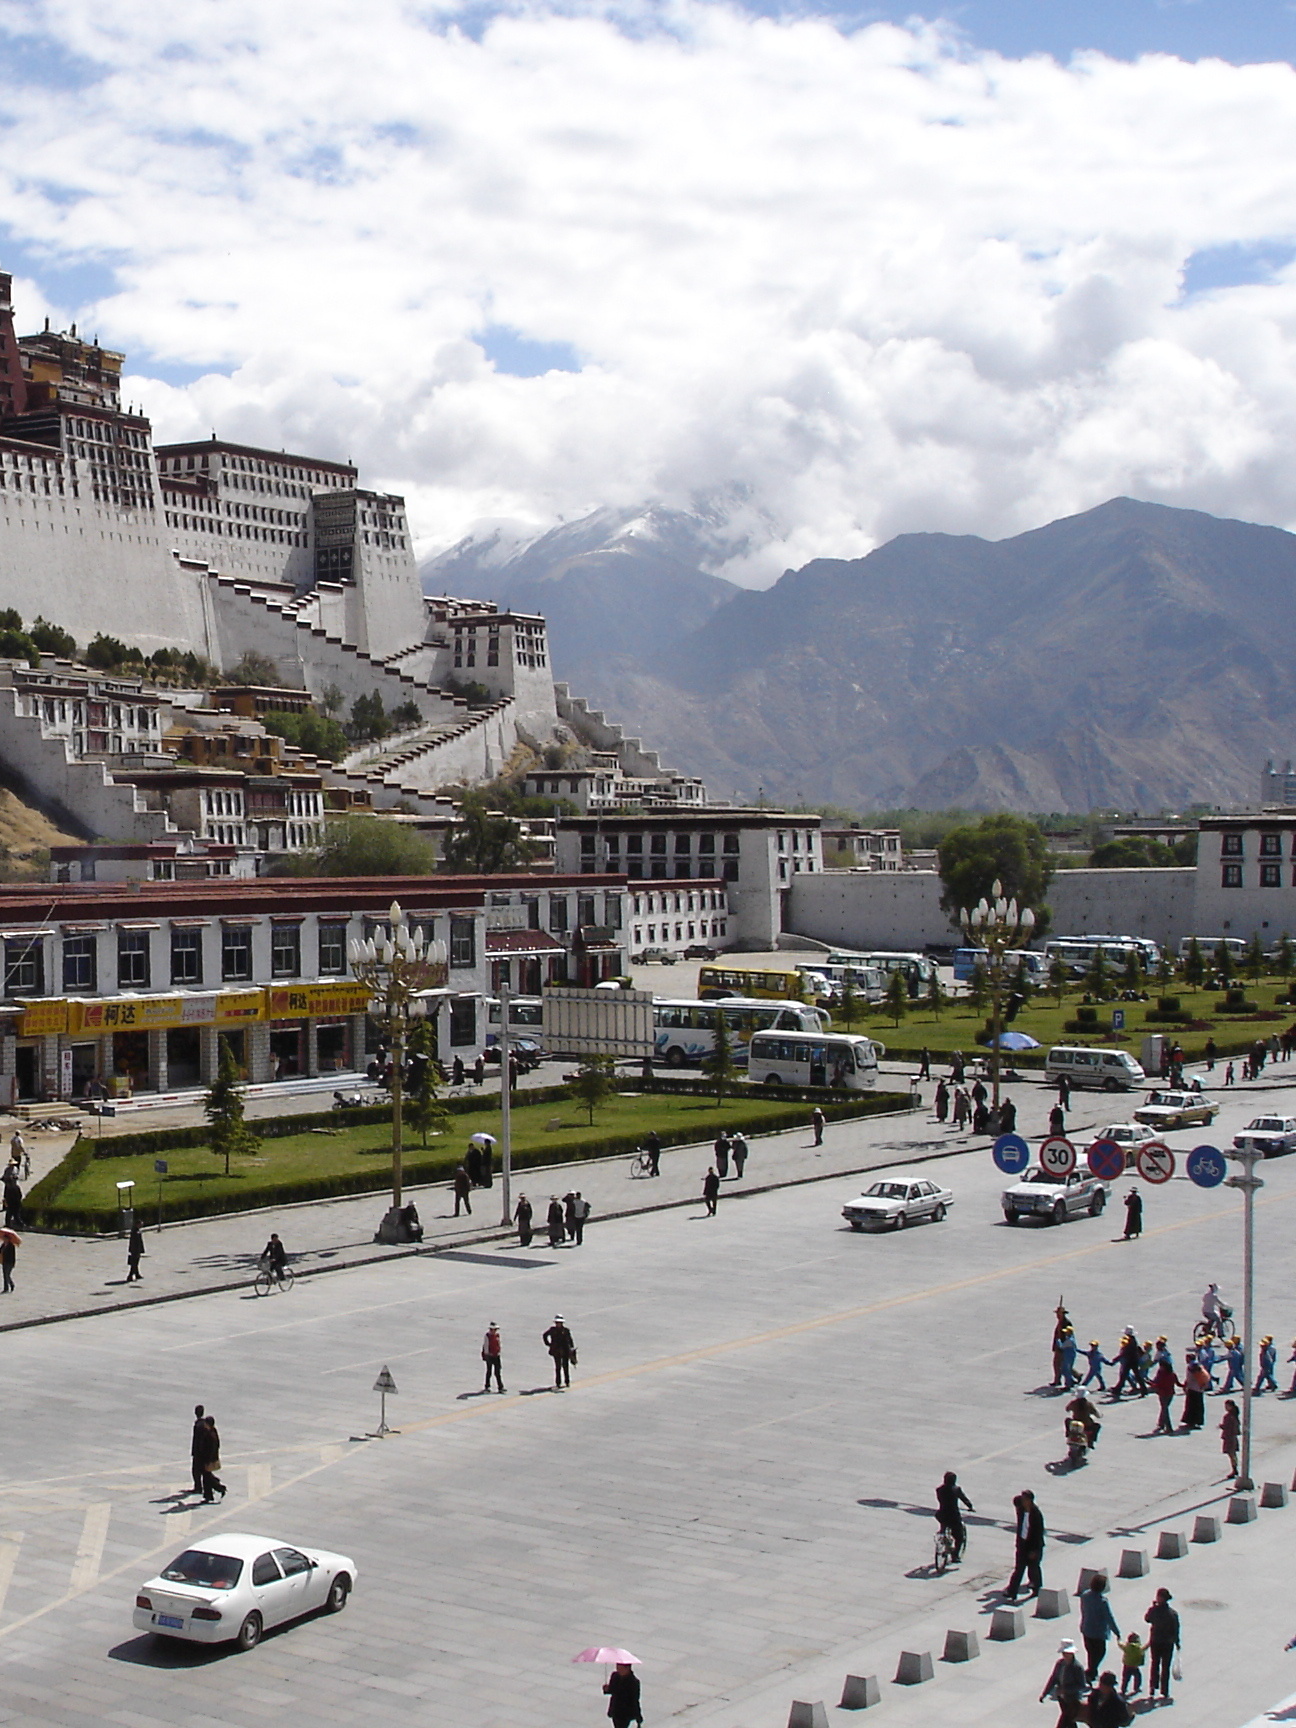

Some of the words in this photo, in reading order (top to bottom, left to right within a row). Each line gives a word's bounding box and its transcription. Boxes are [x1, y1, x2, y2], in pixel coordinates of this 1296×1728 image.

[289, 992, 308, 1010] 柯达
[104, 1004, 136, 1026] 柯达
[1115, 1013, 1122, 1026] P
[1047, 1148, 1070, 1166] 30
